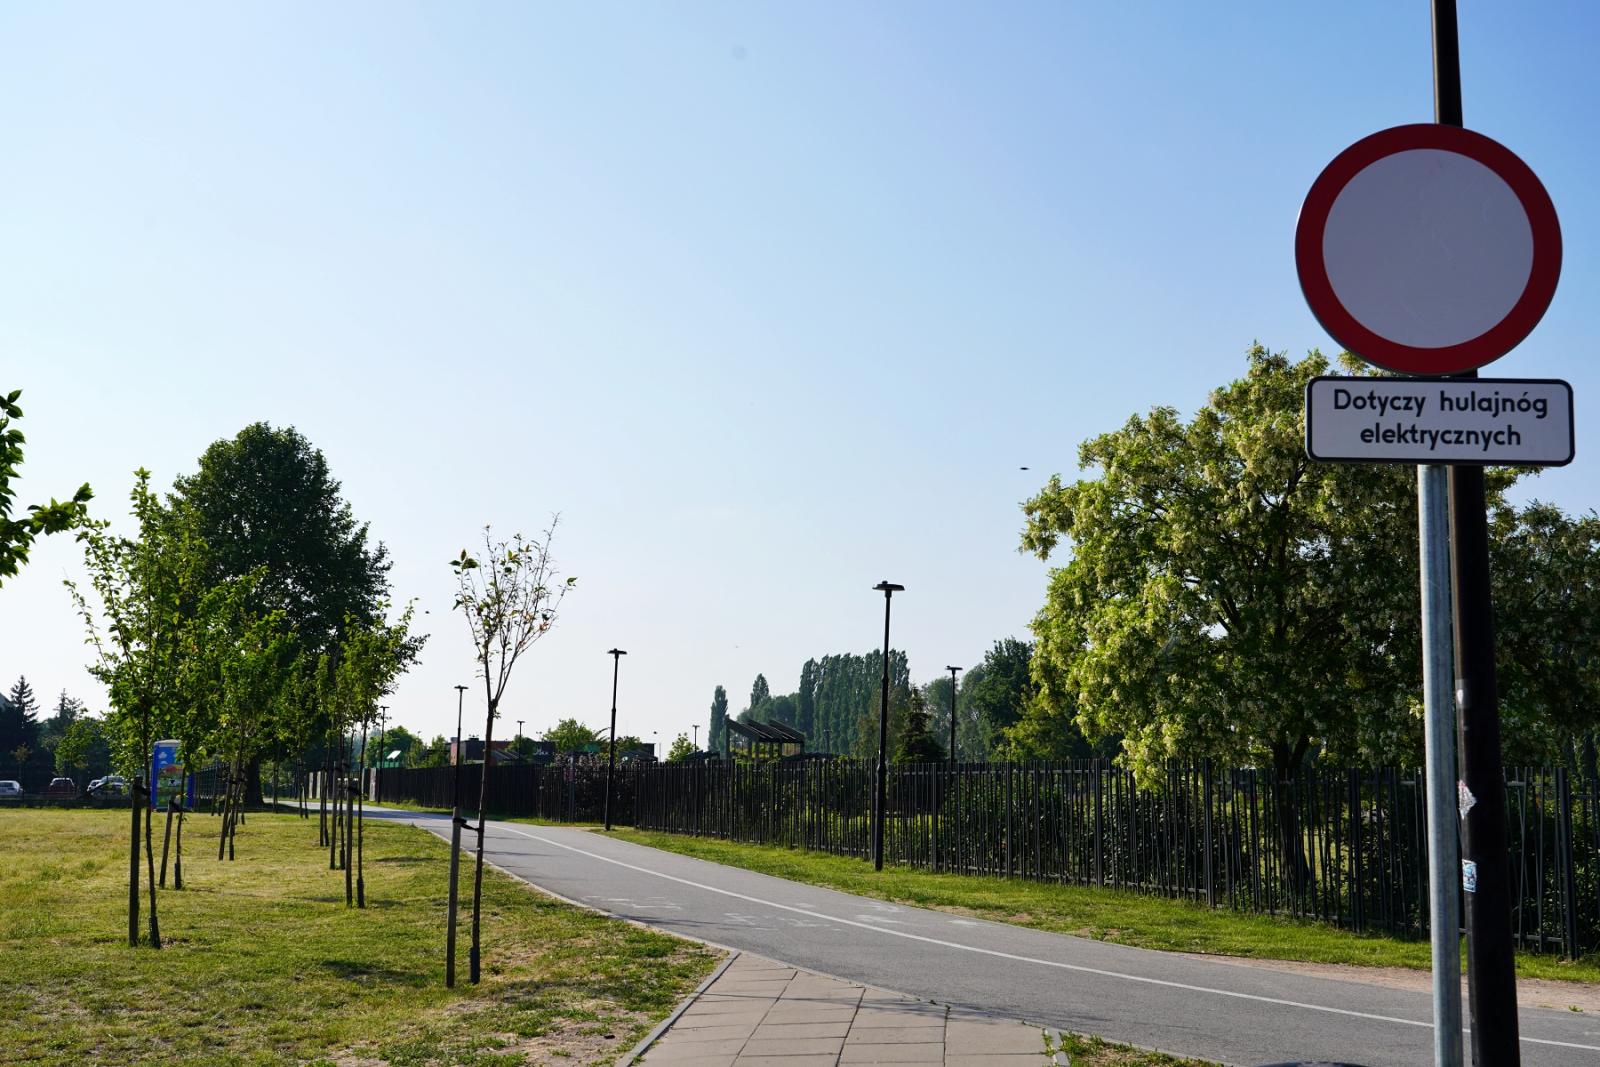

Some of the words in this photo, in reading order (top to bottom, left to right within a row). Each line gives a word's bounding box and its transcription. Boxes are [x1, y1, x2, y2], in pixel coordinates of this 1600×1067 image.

[1334, 389, 1426, 417] Dotyczy
[1440, 390, 1548, 419] hulajnóg
[1360, 423, 1521, 451] elektrycznych
